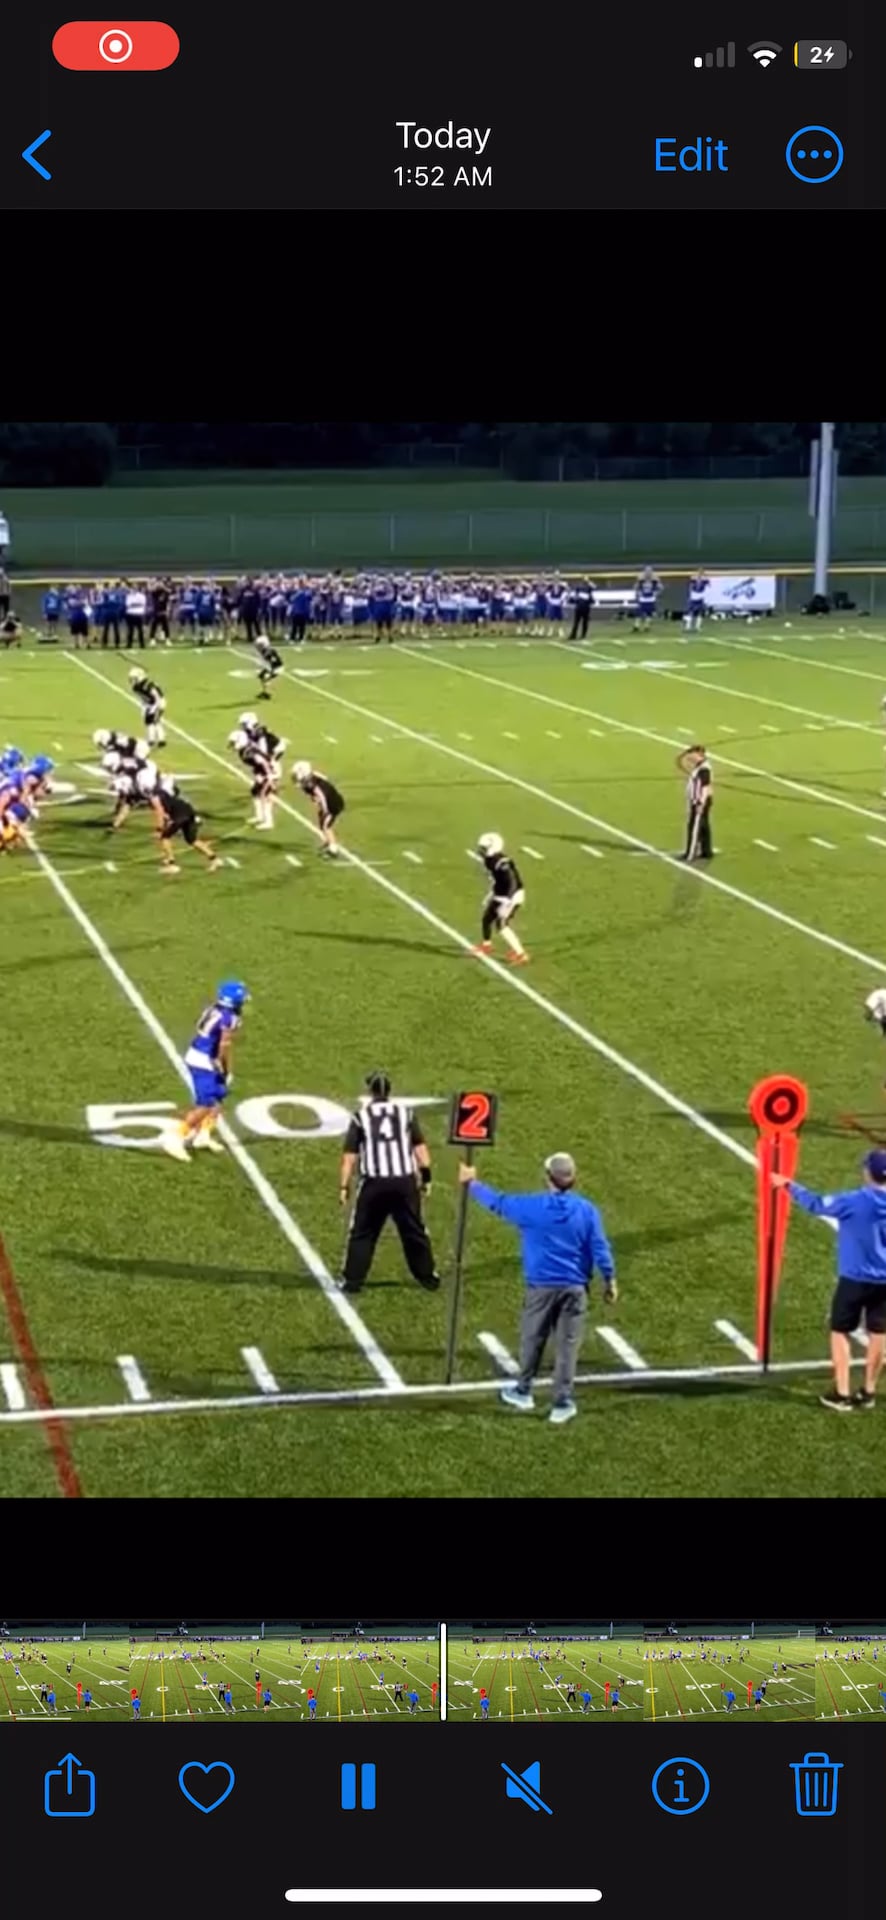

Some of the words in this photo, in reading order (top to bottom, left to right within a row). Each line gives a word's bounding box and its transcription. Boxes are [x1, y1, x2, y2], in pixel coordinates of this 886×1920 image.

[810, 46, 823, 64] 2
[395, 120, 492, 154] Today
[655, 137, 729, 172] Edit
[393, 165, 445, 187] 1:52
[453, 165, 492, 187] AM
[85, 1094, 356, 1148] 50
[458, 1093, 489, 1138] 2
